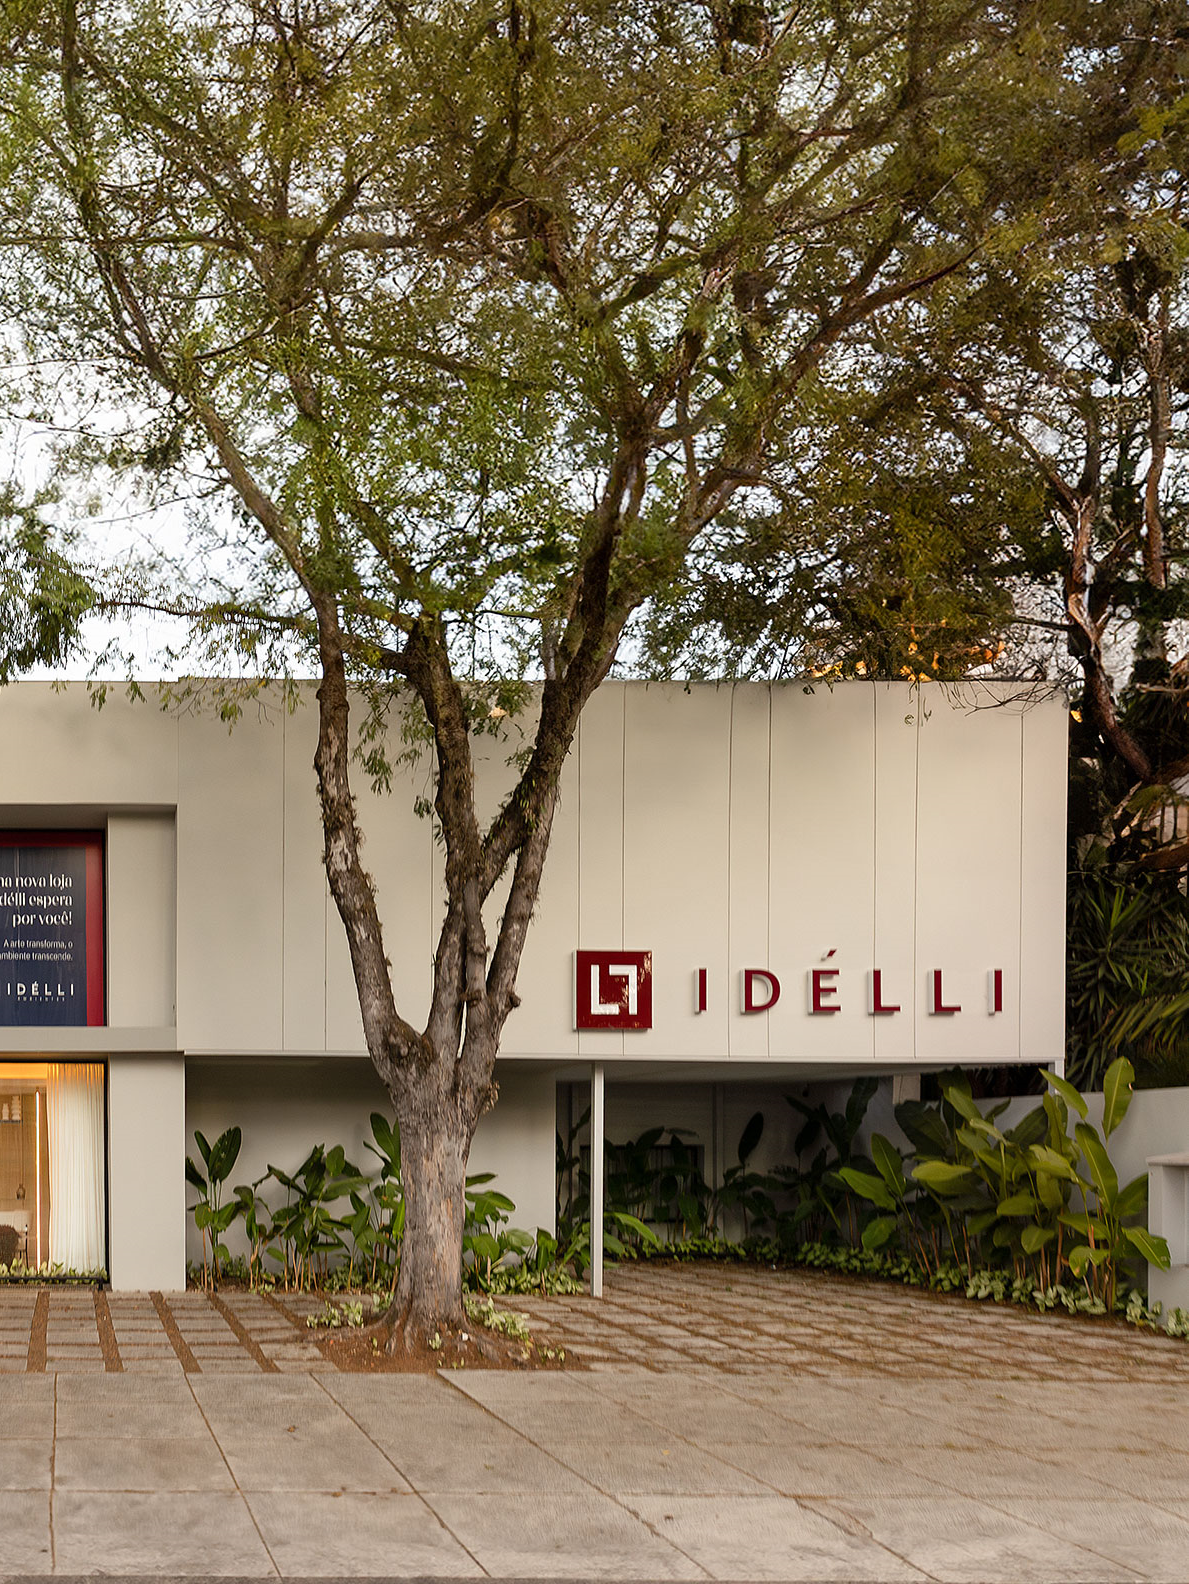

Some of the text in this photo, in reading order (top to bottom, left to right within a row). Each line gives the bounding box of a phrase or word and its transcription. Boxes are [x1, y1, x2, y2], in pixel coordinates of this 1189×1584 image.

[15, 876, 46, 888] nova
[49, 873, 73, 891] loja
[29, 895, 73, 909] espera
[12, 911, 73, 928] por você!
[3, 938, 9, 948] A
[10, 939, 25, 949] arte
[67, 940, 73, 949] o
[7, 981, 74, 996] IDÉLLI
[694, 948, 1003, 1015] IDÉLLI
